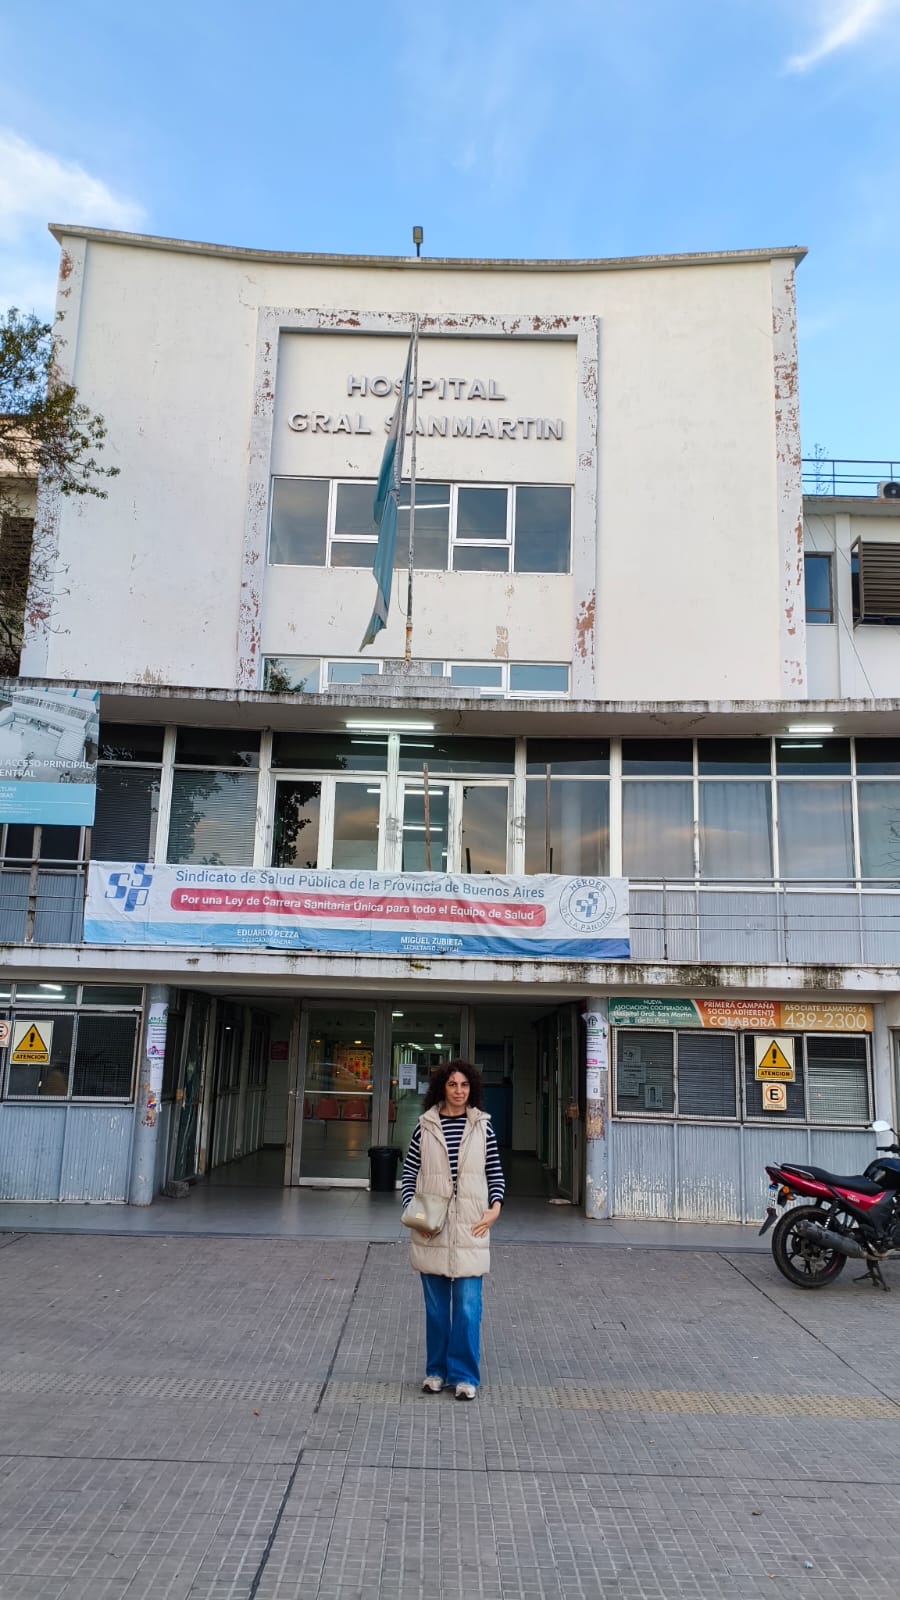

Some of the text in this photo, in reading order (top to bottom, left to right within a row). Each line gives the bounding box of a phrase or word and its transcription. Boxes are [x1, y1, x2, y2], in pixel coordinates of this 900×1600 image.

[347, 375, 506, 400] HOSPITAL
[287, 411, 372, 435] GRAL
[4, 759, 41, 767] ACCESO
[0, 769, 36, 778] ENTRAL
[176, 870, 545, 899] Sindicato de Salud Pública de la Provincia de Buenos Aires
[181, 894, 534, 921] Por una Ley de Carrera Sanitaria Única para todo el Equipo de Salud
[237, 928, 299, 938] EDUARDO PEZZA
[400, 936, 463, 946] MIGUEL ZUBIETA
[707, 1008, 774, 1017] SOCIO ADHERENTE
[709, 1015, 776, 1027] COLABORÁ
[784, 1012, 868, 1029] 439-2300
[769, 1088, 779, 1101] E
